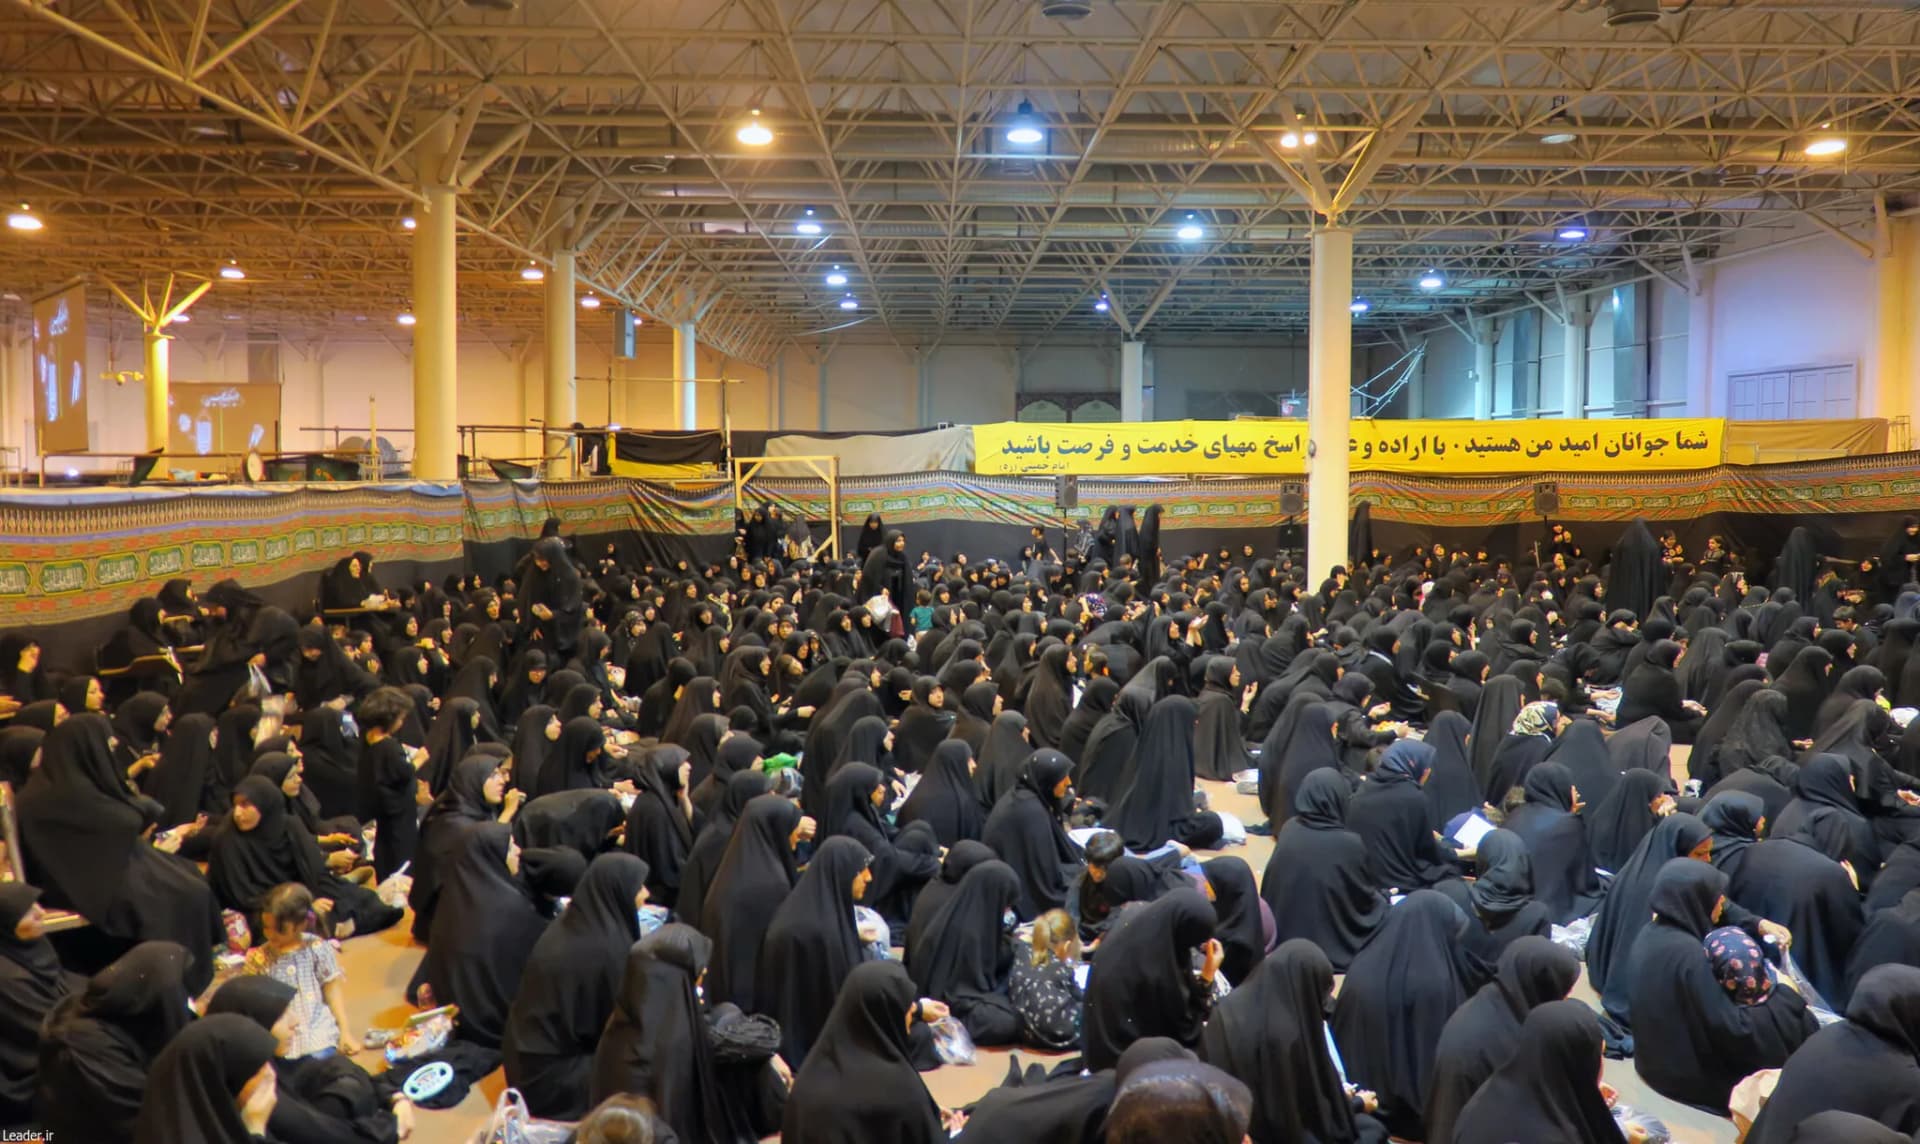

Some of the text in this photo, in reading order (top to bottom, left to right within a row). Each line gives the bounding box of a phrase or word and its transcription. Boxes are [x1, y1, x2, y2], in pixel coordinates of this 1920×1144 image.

[1002, 435, 1050, 460] باشید
[1057, 433, 1114, 461] فرصت
[1120, 443, 1131, 461] و
[1137, 433, 1198, 454] خدمت
[1203, 434, 1257, 459] مهیای
[1361, 441, 1373, 459] و
[1379, 434, 1427, 461] اراده
[1433, 435, 1446, 460] با
[1526, 439, 1553, 458] من
[1559, 431, 1598, 457] امید
[1604, 431, 1669, 458] جوانان
[1676, 430, 1708, 450] شما
